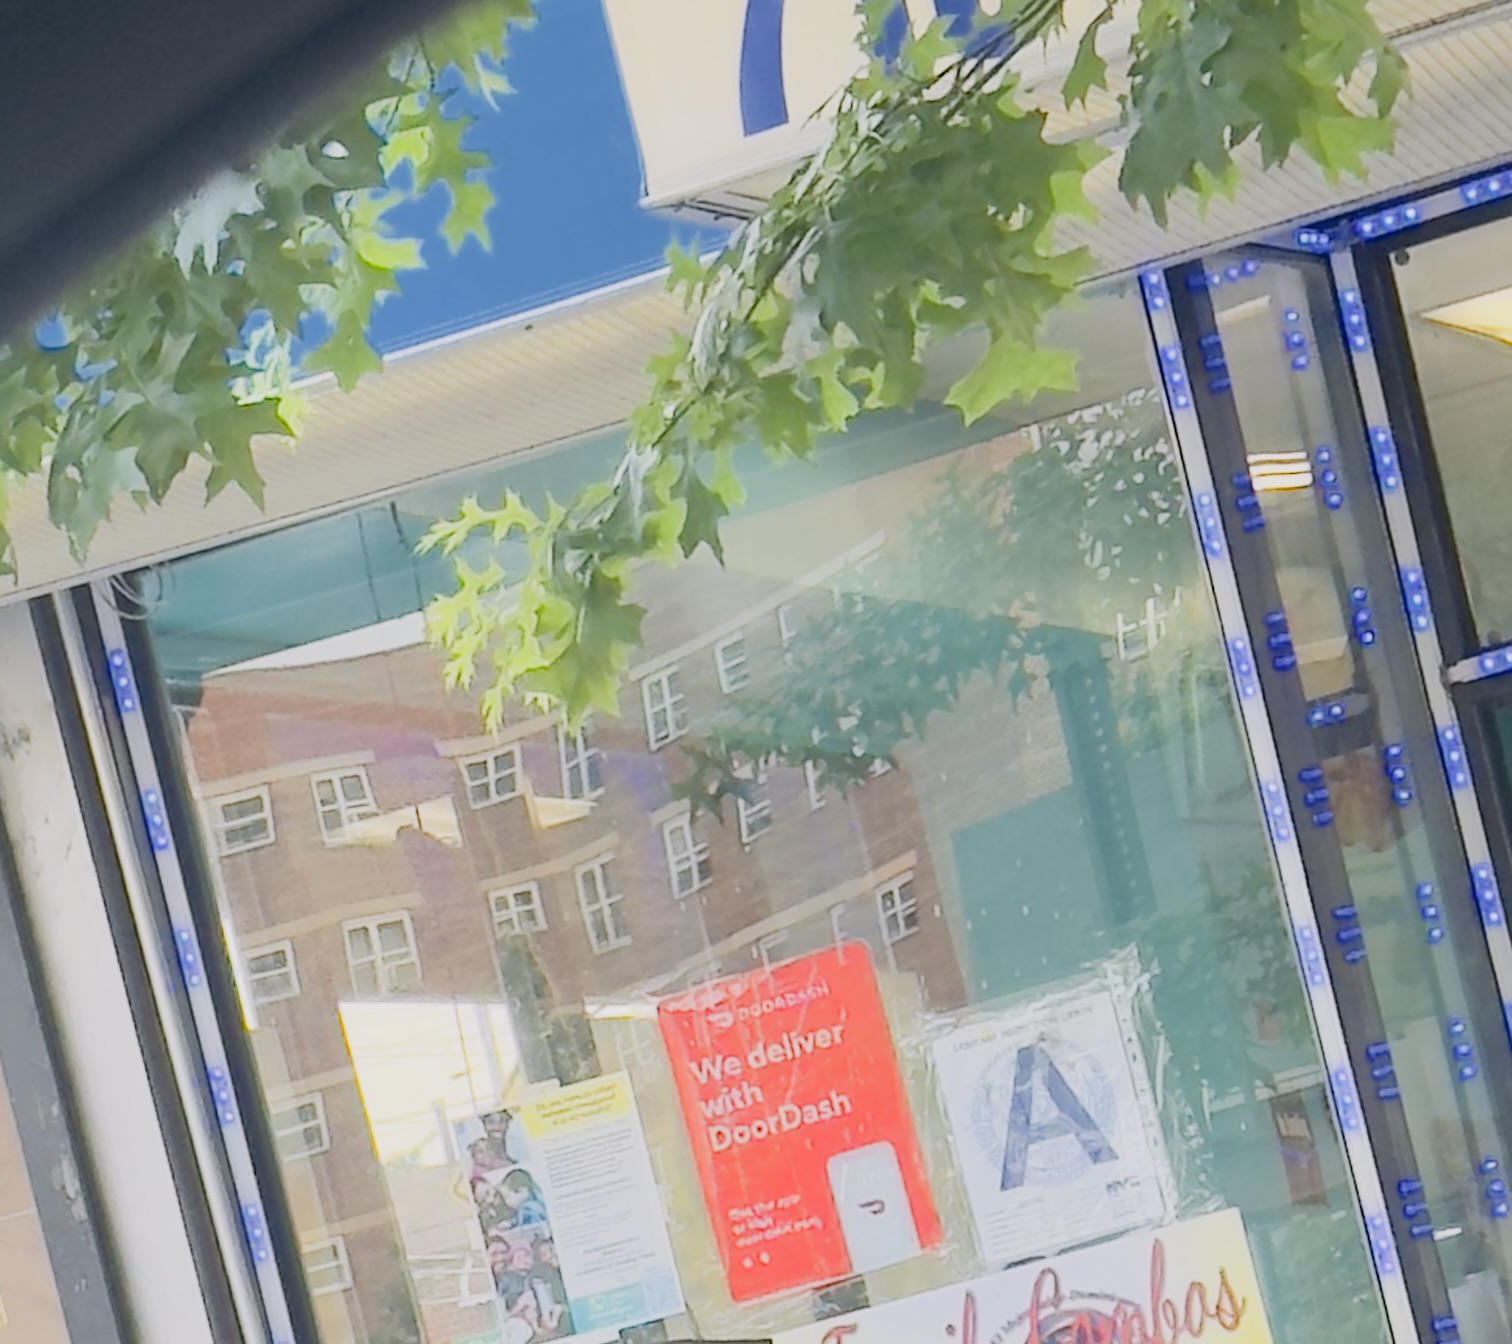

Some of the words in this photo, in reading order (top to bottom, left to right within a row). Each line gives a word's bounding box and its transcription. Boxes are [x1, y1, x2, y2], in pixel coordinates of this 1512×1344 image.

[738, 982, 830, 1022] DOORDASH
[689, 1055, 743, 1084] We
[747, 1022, 846, 1069] deliver
[699, 1080, 764, 1120] with
[708, 1090, 854, 1153] DoorDash
[1000, 1043, 1119, 1192] A
